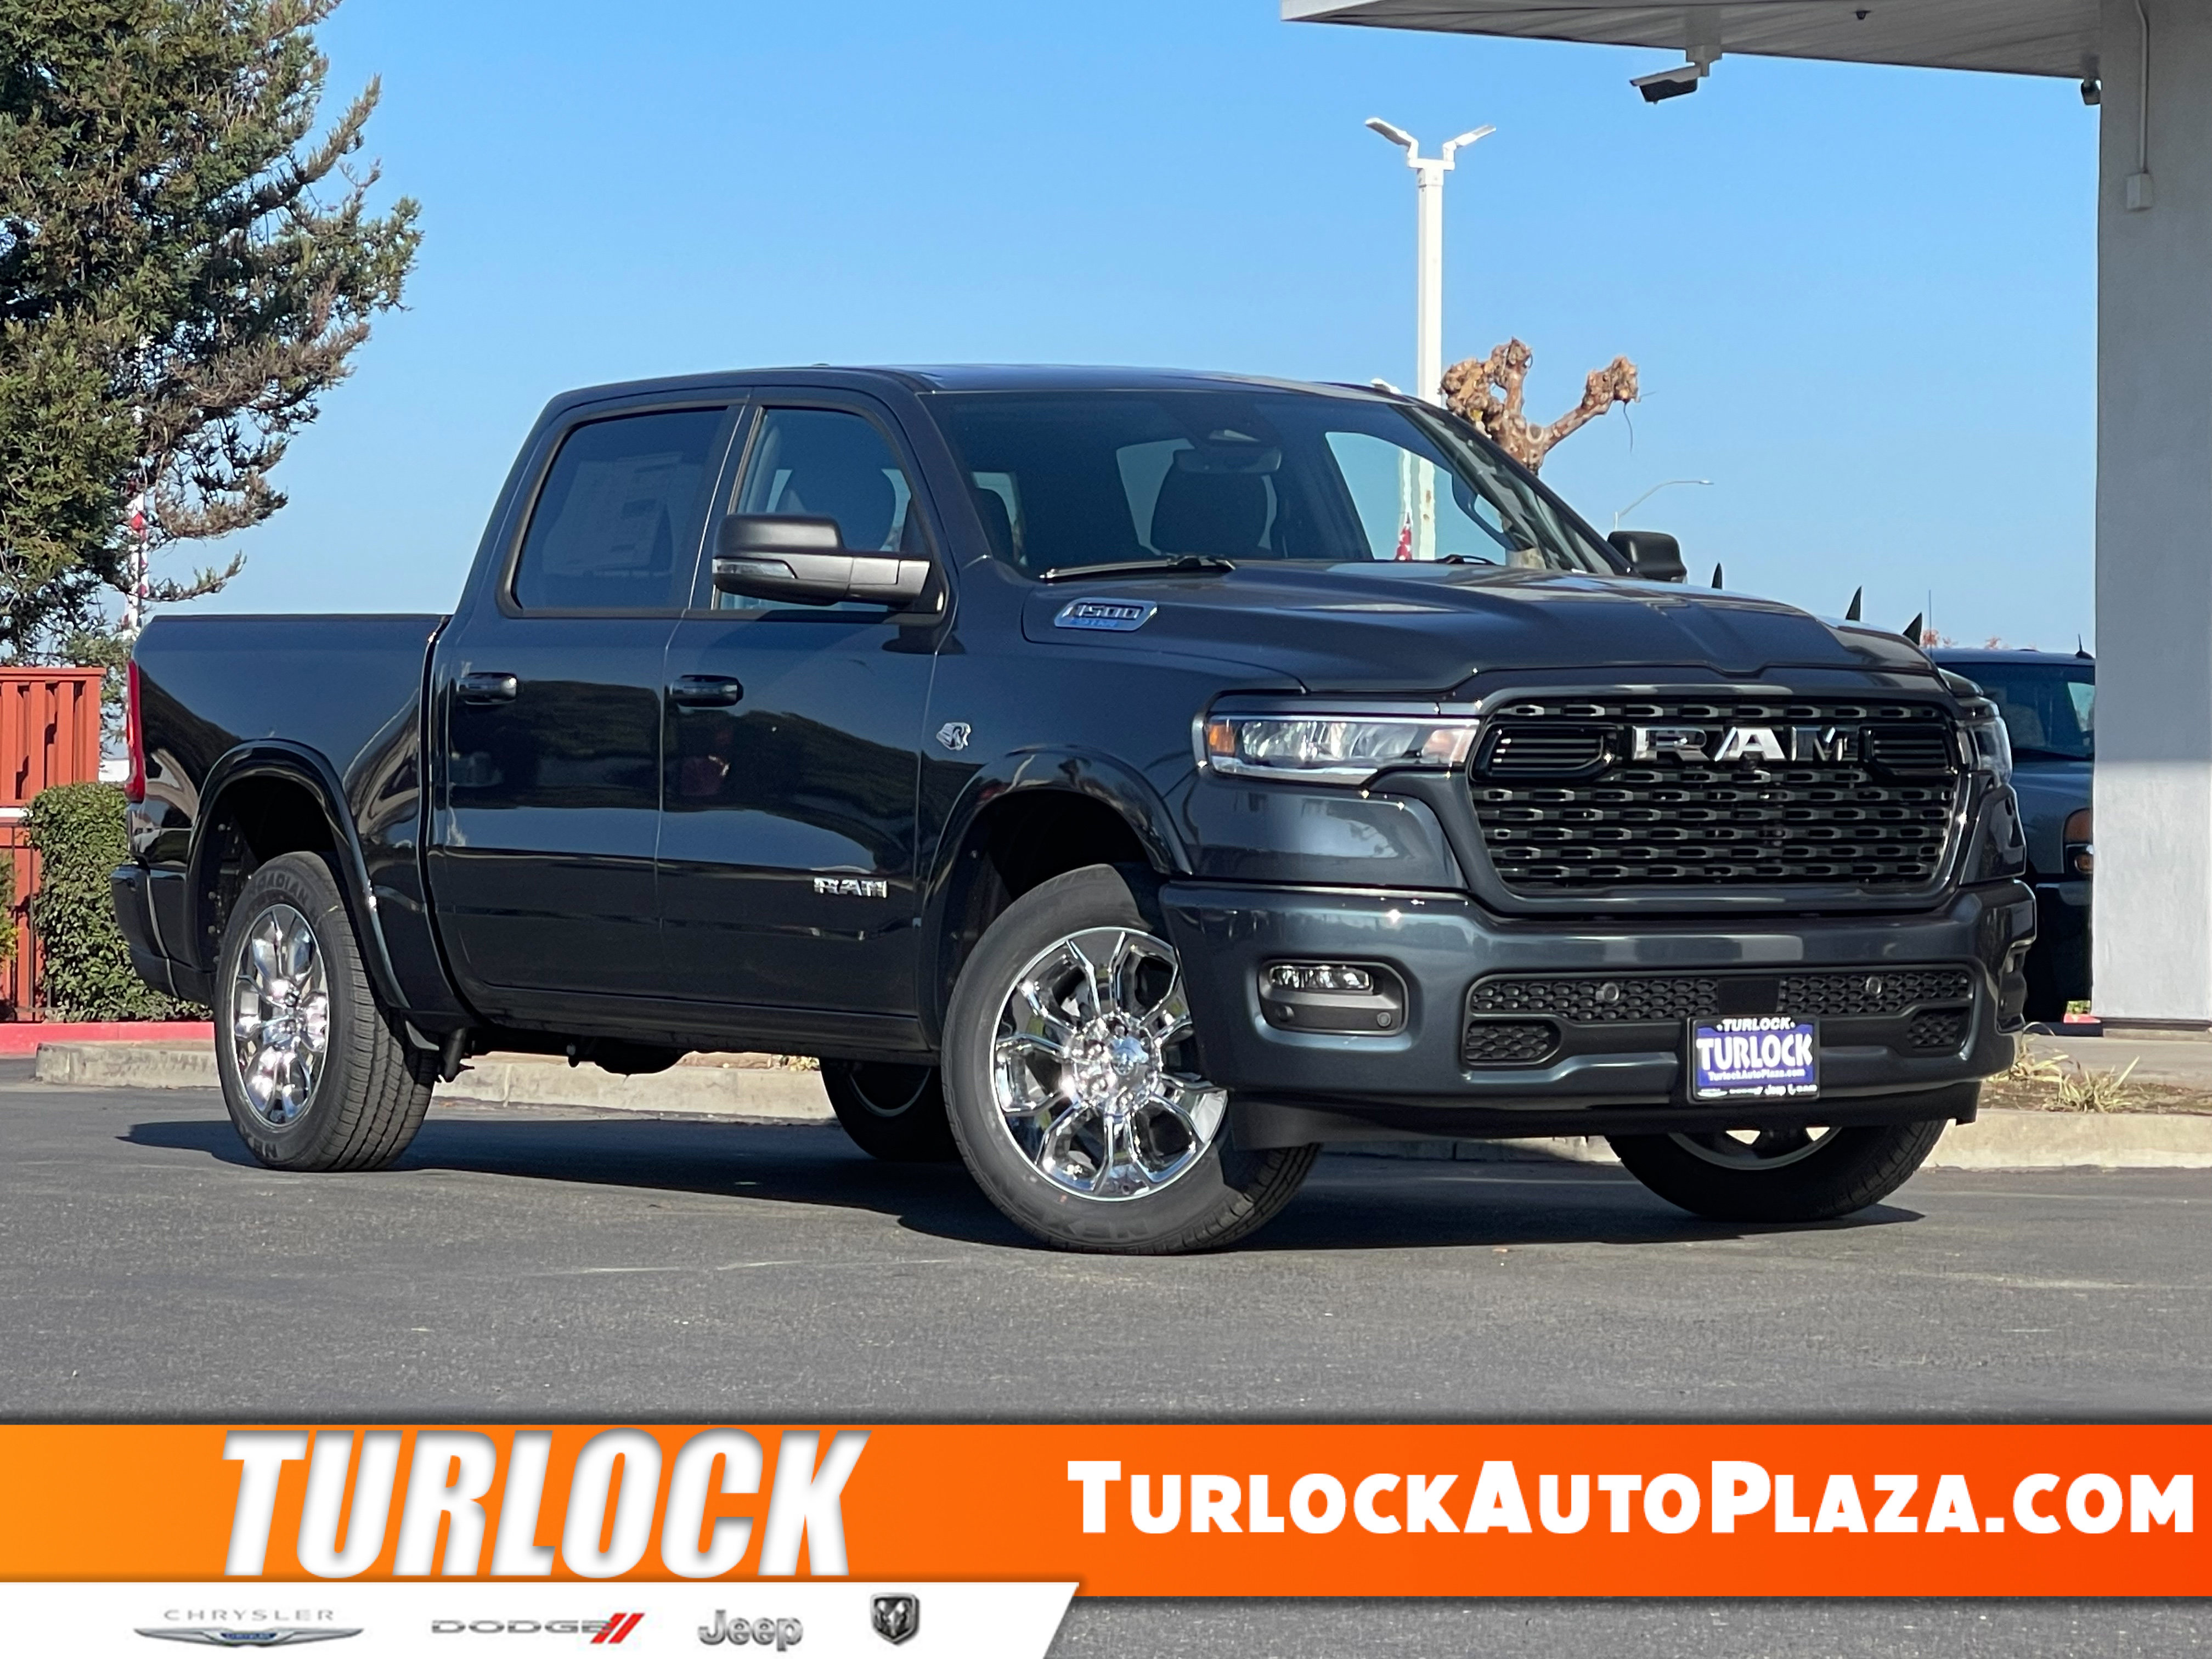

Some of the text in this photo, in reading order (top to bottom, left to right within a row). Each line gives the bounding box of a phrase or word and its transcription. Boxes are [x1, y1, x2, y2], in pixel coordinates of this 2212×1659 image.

[1076, 604, 1142, 618] 1500
[1632, 726, 1849, 761] RAM
[814, 878, 887, 898] RAM
[1722, 1017, 1791, 1032] TURLOCK
[1696, 1034, 1813, 1070] TURLOCK
